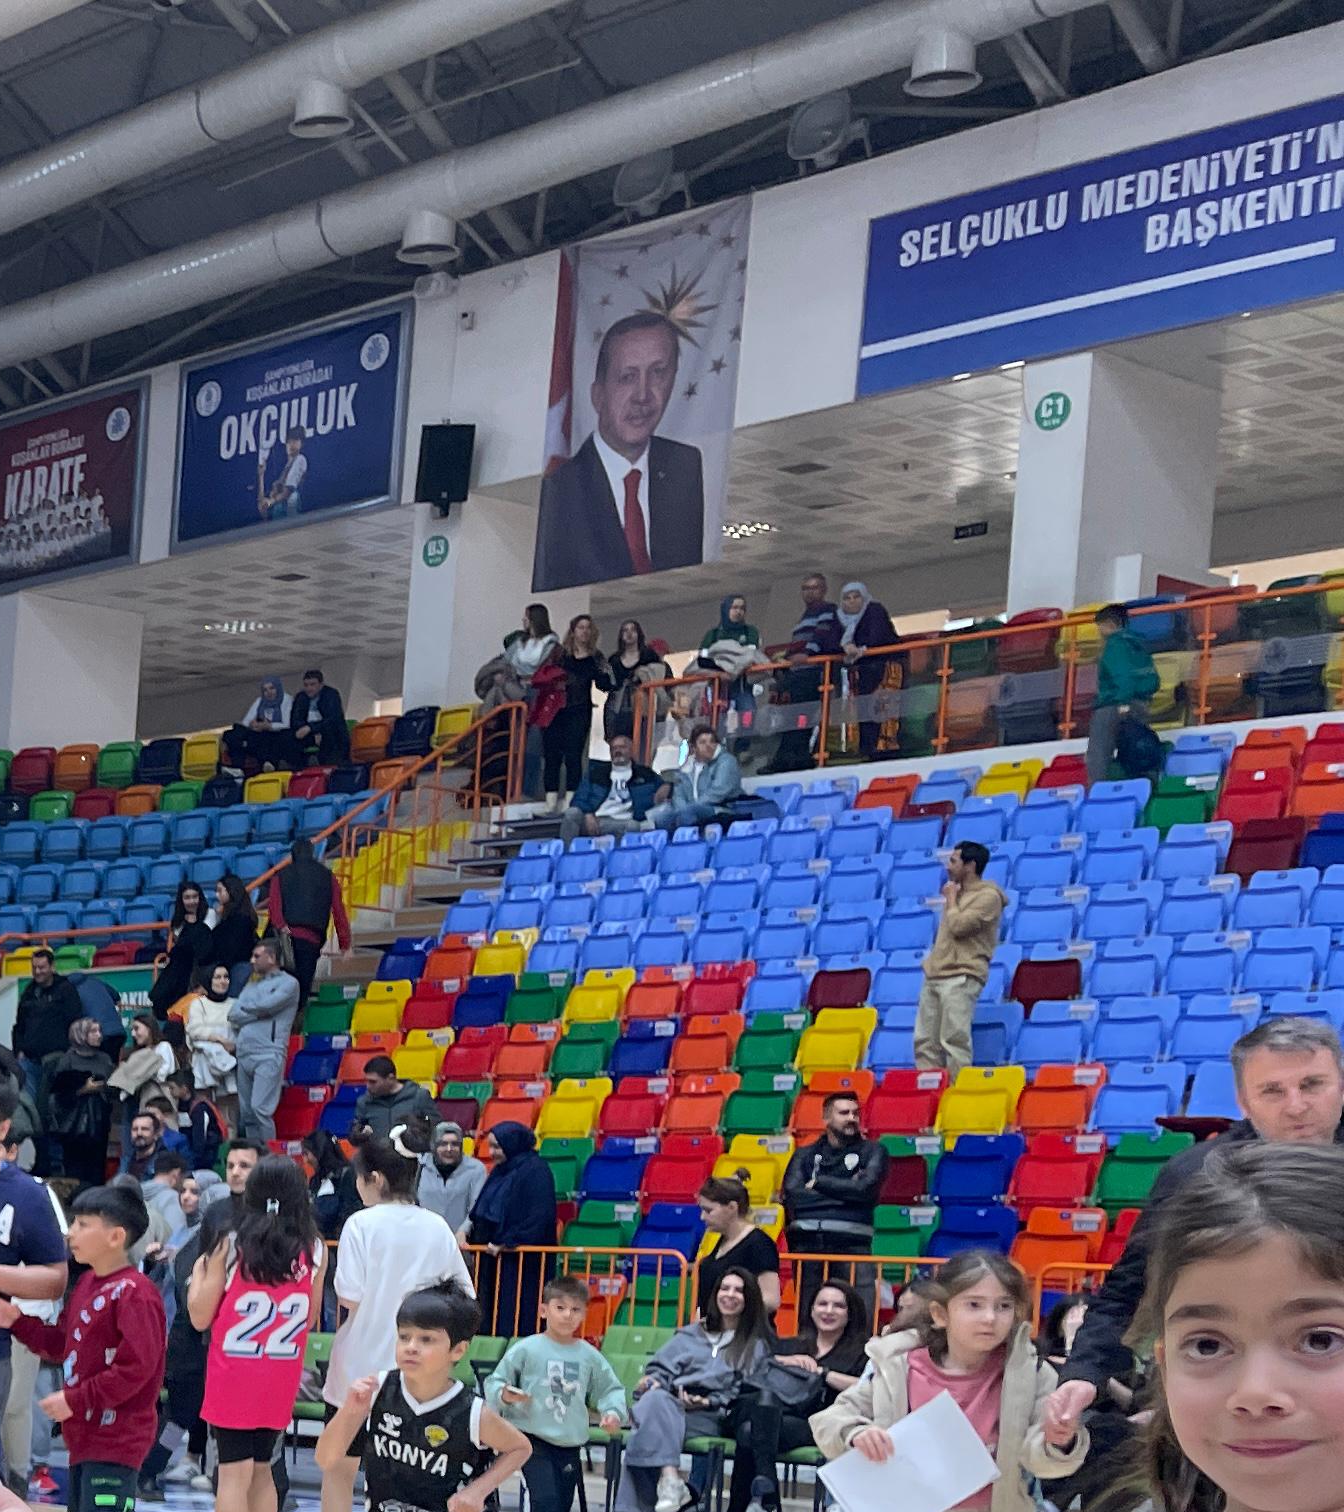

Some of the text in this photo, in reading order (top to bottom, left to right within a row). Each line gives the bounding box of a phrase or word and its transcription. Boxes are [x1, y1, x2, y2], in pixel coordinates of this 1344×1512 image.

[899, 190, 1070, 268] SELÇUKLU
[1041, 396, 1066, 419] C1
[222, 1290, 310, 1360] 22
[373, 1434, 449, 1477] KONYA
